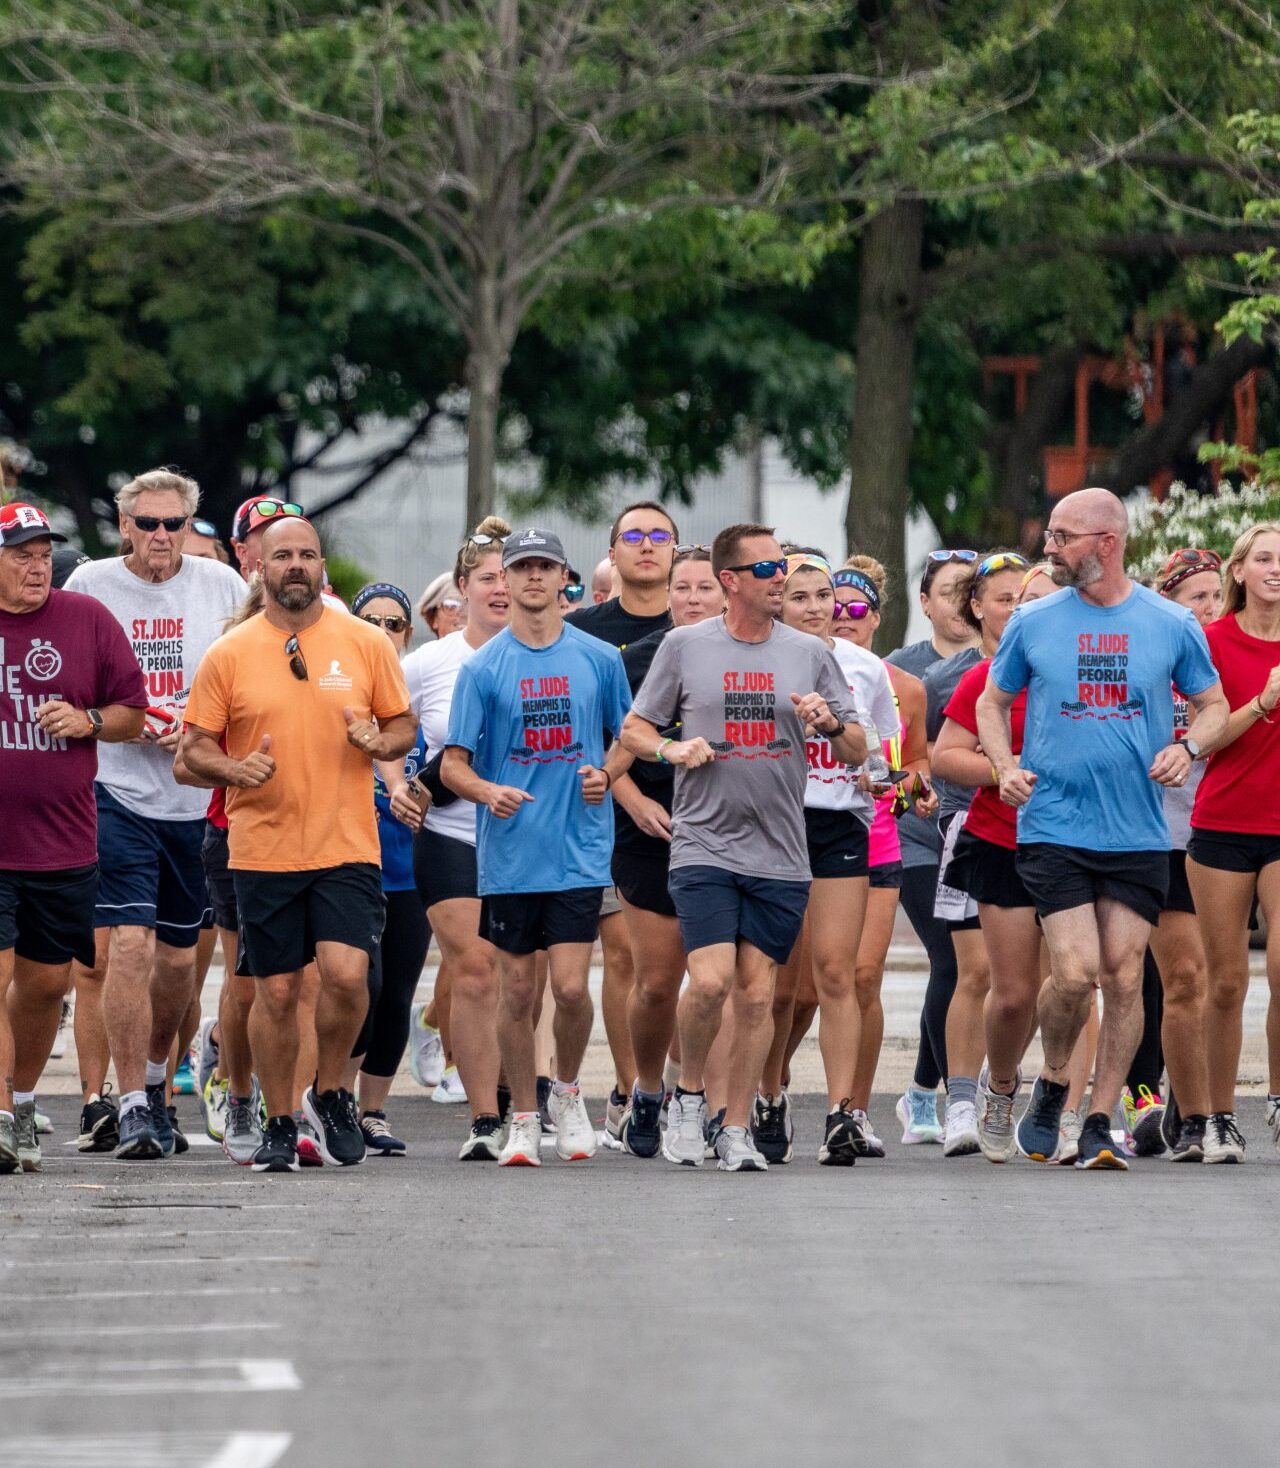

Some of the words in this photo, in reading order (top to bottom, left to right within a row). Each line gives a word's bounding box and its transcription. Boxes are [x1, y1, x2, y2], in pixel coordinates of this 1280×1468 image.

[831, 573, 866, 591] UN
[133, 640, 183, 656] MEMPHIS
[136, 656, 143, 671] O
[148, 656, 183, 671] PEORIA
[1078, 654, 1116, 667] MEMPHIS
[1118, 654, 1128, 667] TO
[1078, 668, 1127, 682] PEORIA
[724, 692, 763, 706] MEMPHIS
[765, 692, 775, 705] TO
[1078, 683, 1127, 708] RUN
[10, 693, 63, 722] TH
[522, 698, 559, 713] MEMPHIS
[560, 697, 571, 711] TO
[724, 706, 775, 720] PEORIA
[523, 711, 572, 728] PEORIA
[524, 725, 572, 752] RUN
[725, 721, 775, 747] RUN
[805, 742, 846, 770] RU
